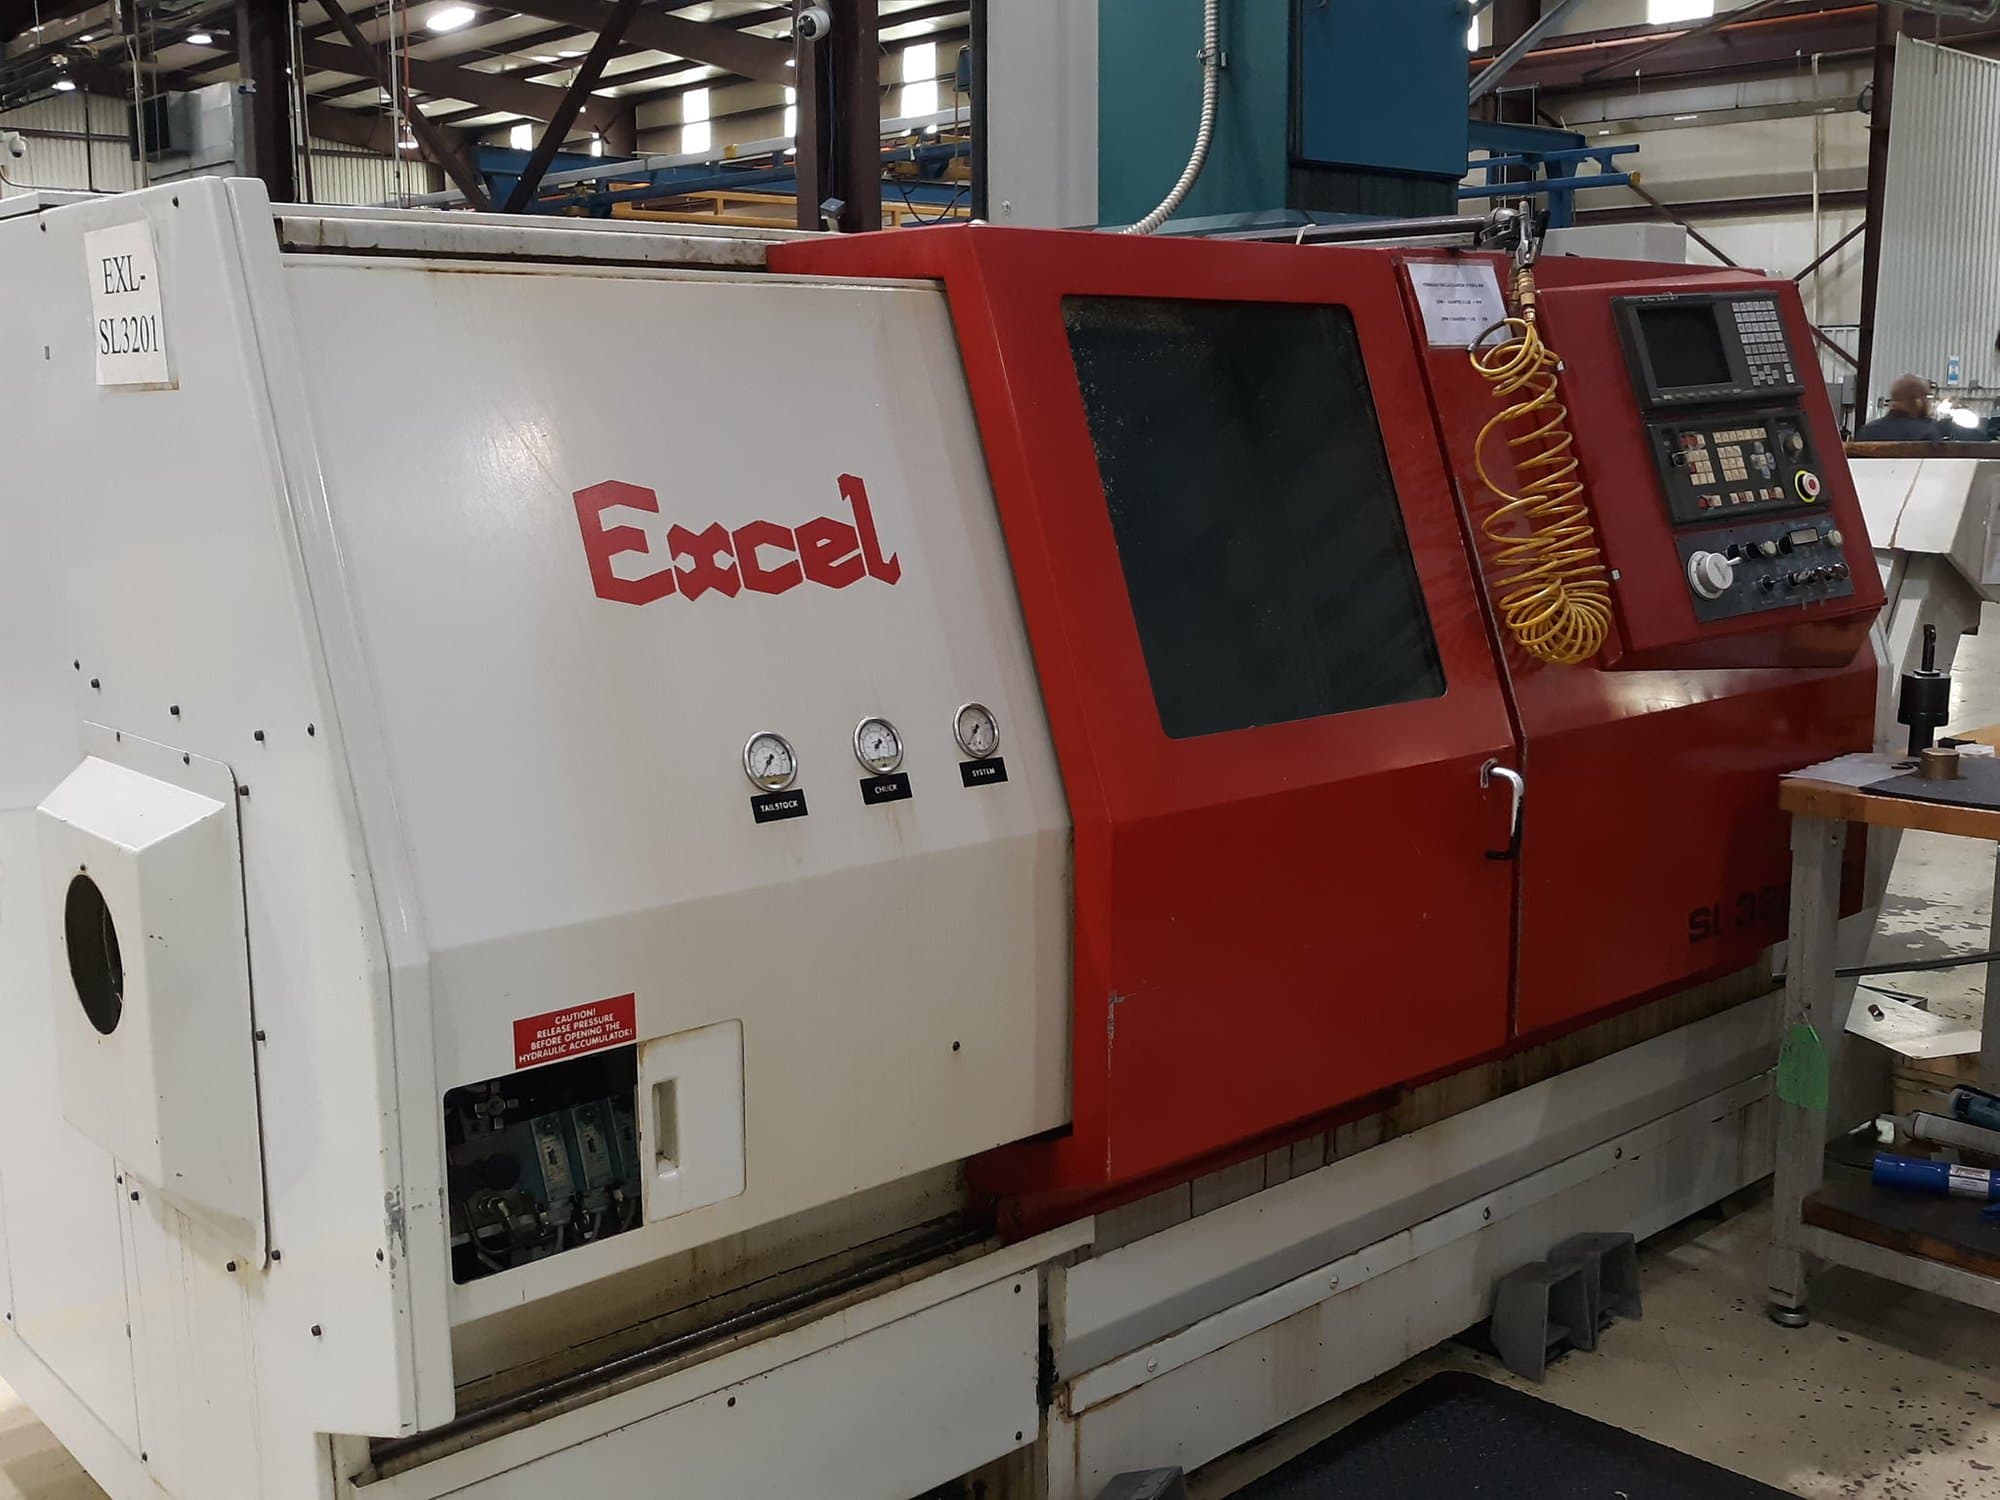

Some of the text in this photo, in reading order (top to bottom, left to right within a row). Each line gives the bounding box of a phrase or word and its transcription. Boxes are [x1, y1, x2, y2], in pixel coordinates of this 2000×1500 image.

[102, 254, 146, 295] EXL-
[98, 314, 159, 356] SL3201
[571, 472, 903, 607] Excel
[971, 767, 997, 778] SYSTEM
[874, 783, 898, 795] CHUCK
[760, 799, 799, 813] TAILSTOCK
[536, 1013, 615, 1039] RELEASE PRESSURE
[554, 1007, 597, 1025] CAUTION!
[518, 1027, 633, 1063] HYDRAULIC ACCUMULATOR!
[530, 1021, 621, 1051] BEFORE OPENING THE
